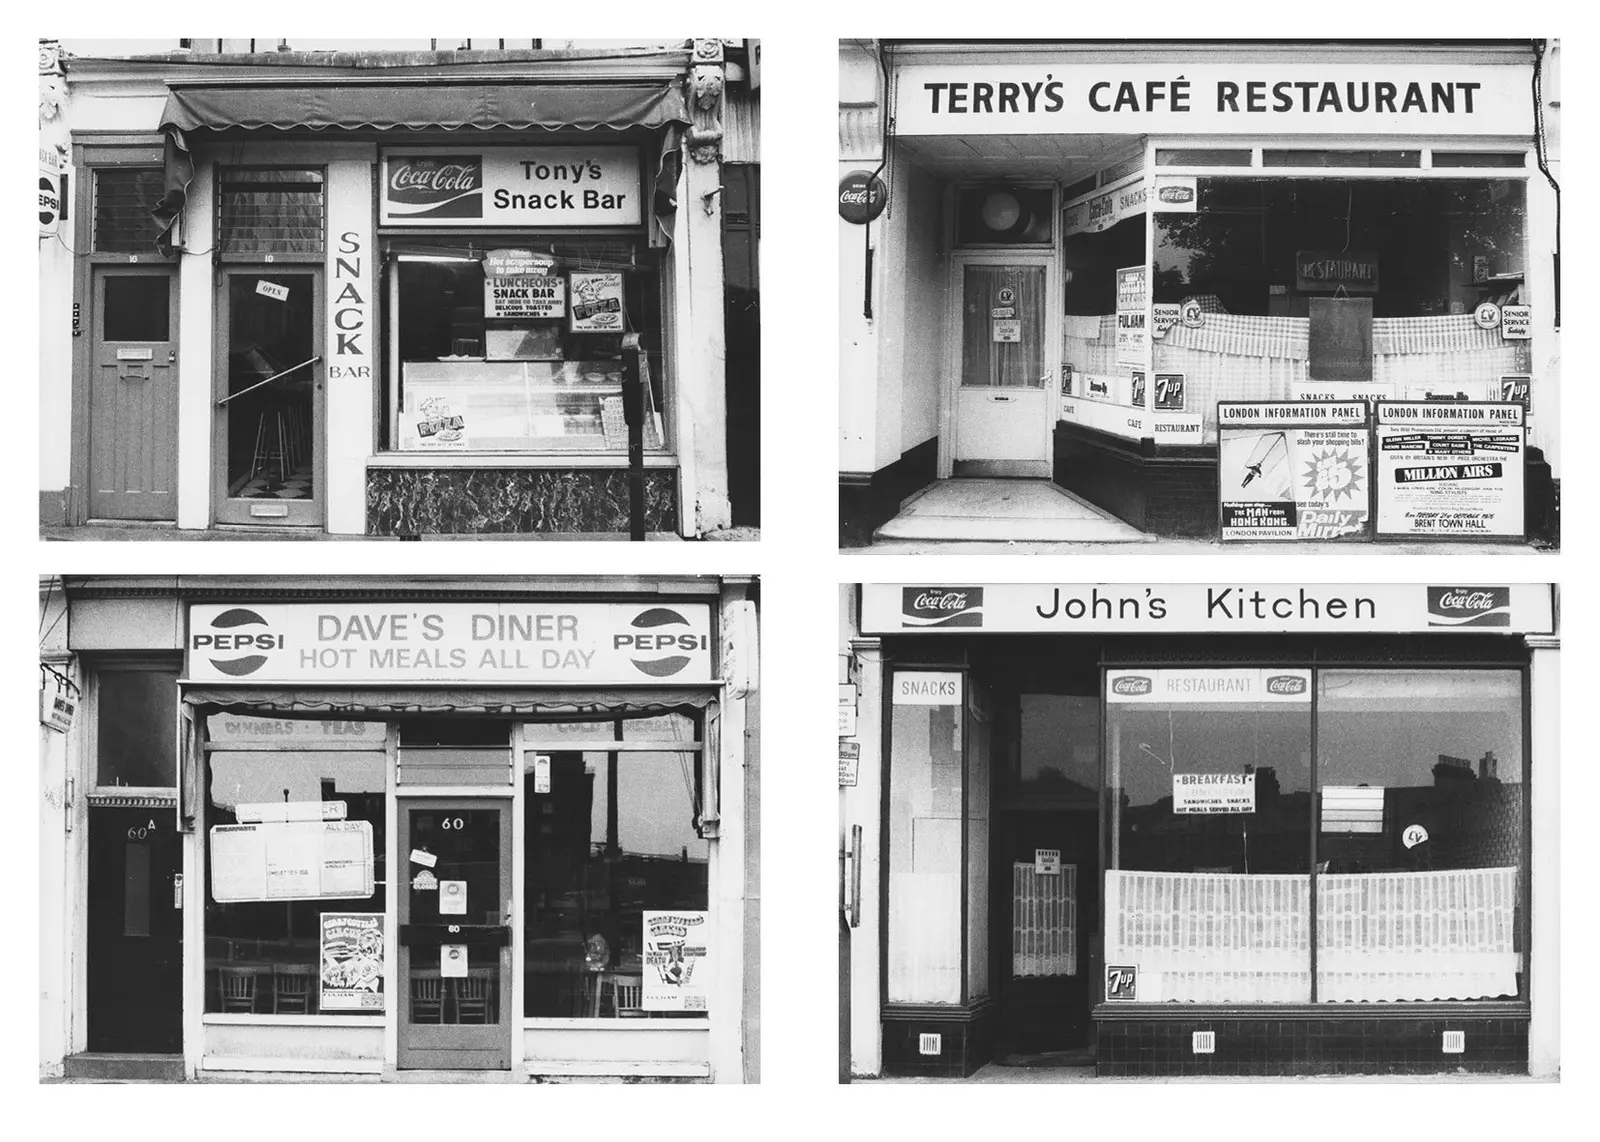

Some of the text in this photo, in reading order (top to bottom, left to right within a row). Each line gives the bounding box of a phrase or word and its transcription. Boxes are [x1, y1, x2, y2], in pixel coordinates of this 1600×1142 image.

[925, 74, 1481, 114] TERRY'S CAFÉ RESTAURANT
[391, 165, 477, 191] Coca-Cola
[520, 160, 602, 184] Tony's
[494, 188, 626, 210] Snack Bar
[1120, 188, 1147, 210] SNACKS
[264, 255, 274, 263] 10
[1303, 260, 1372, 280] RESTAURANT
[494, 278, 558, 288] LUNCHEONS
[262, 284, 283, 297] OPEN
[335, 232, 365, 355] SNACK
[494, 289, 554, 298] SNACK BAR
[1504, 310, 1529, 318] SENIOR
[1119, 315, 1145, 328] FULHAM
[1504, 318, 1530, 326] SERVICE
[329, 366, 370, 379] BAR
[1223, 407, 1360, 418] LONDON INFORMATION PANEL
[1383, 407, 1518, 419] LONDON INFORMATION PANEL
[419, 417, 464, 437] PIZZA
[1128, 418, 1143, 430] CAFE
[1155, 424, 1200, 433] RESTAURANT
[1484, 444, 1517, 452] CARPENTERS
[1403, 465, 1493, 482] MILLION AIRS
[1246, 508, 1269, 517] MAN
[1308, 502, 1329, 510] today's
[1230, 517, 1258, 527] HONG
[1300, 510, 1352, 526] Daily
[1414, 519, 1486, 528] BRENT TOWN HALL
[914, 592, 968, 609] Coca-Cola
[1036, 588, 1376, 620] John's Kitchen
[1439, 592, 1495, 609] Coca-Cola
[194, 614, 707, 650] PEPSI DAVE'S DINER PEPSI
[300, 648, 596, 669] HOT MEALS ALL DAY
[902, 681, 956, 696] SNACKS
[1115, 679, 1304, 693] Coca-Cola RESTAURANT Coca-Cola
[321, 720, 366, 735] TEAS
[1182, 775, 1248, 785] BREAKFAST
[215, 822, 362, 833] BREAKFASTS ALL DAY
[442, 818, 465, 830] 60
[448, 925, 461, 933] 60
[646, 957, 667, 965] DEATH
